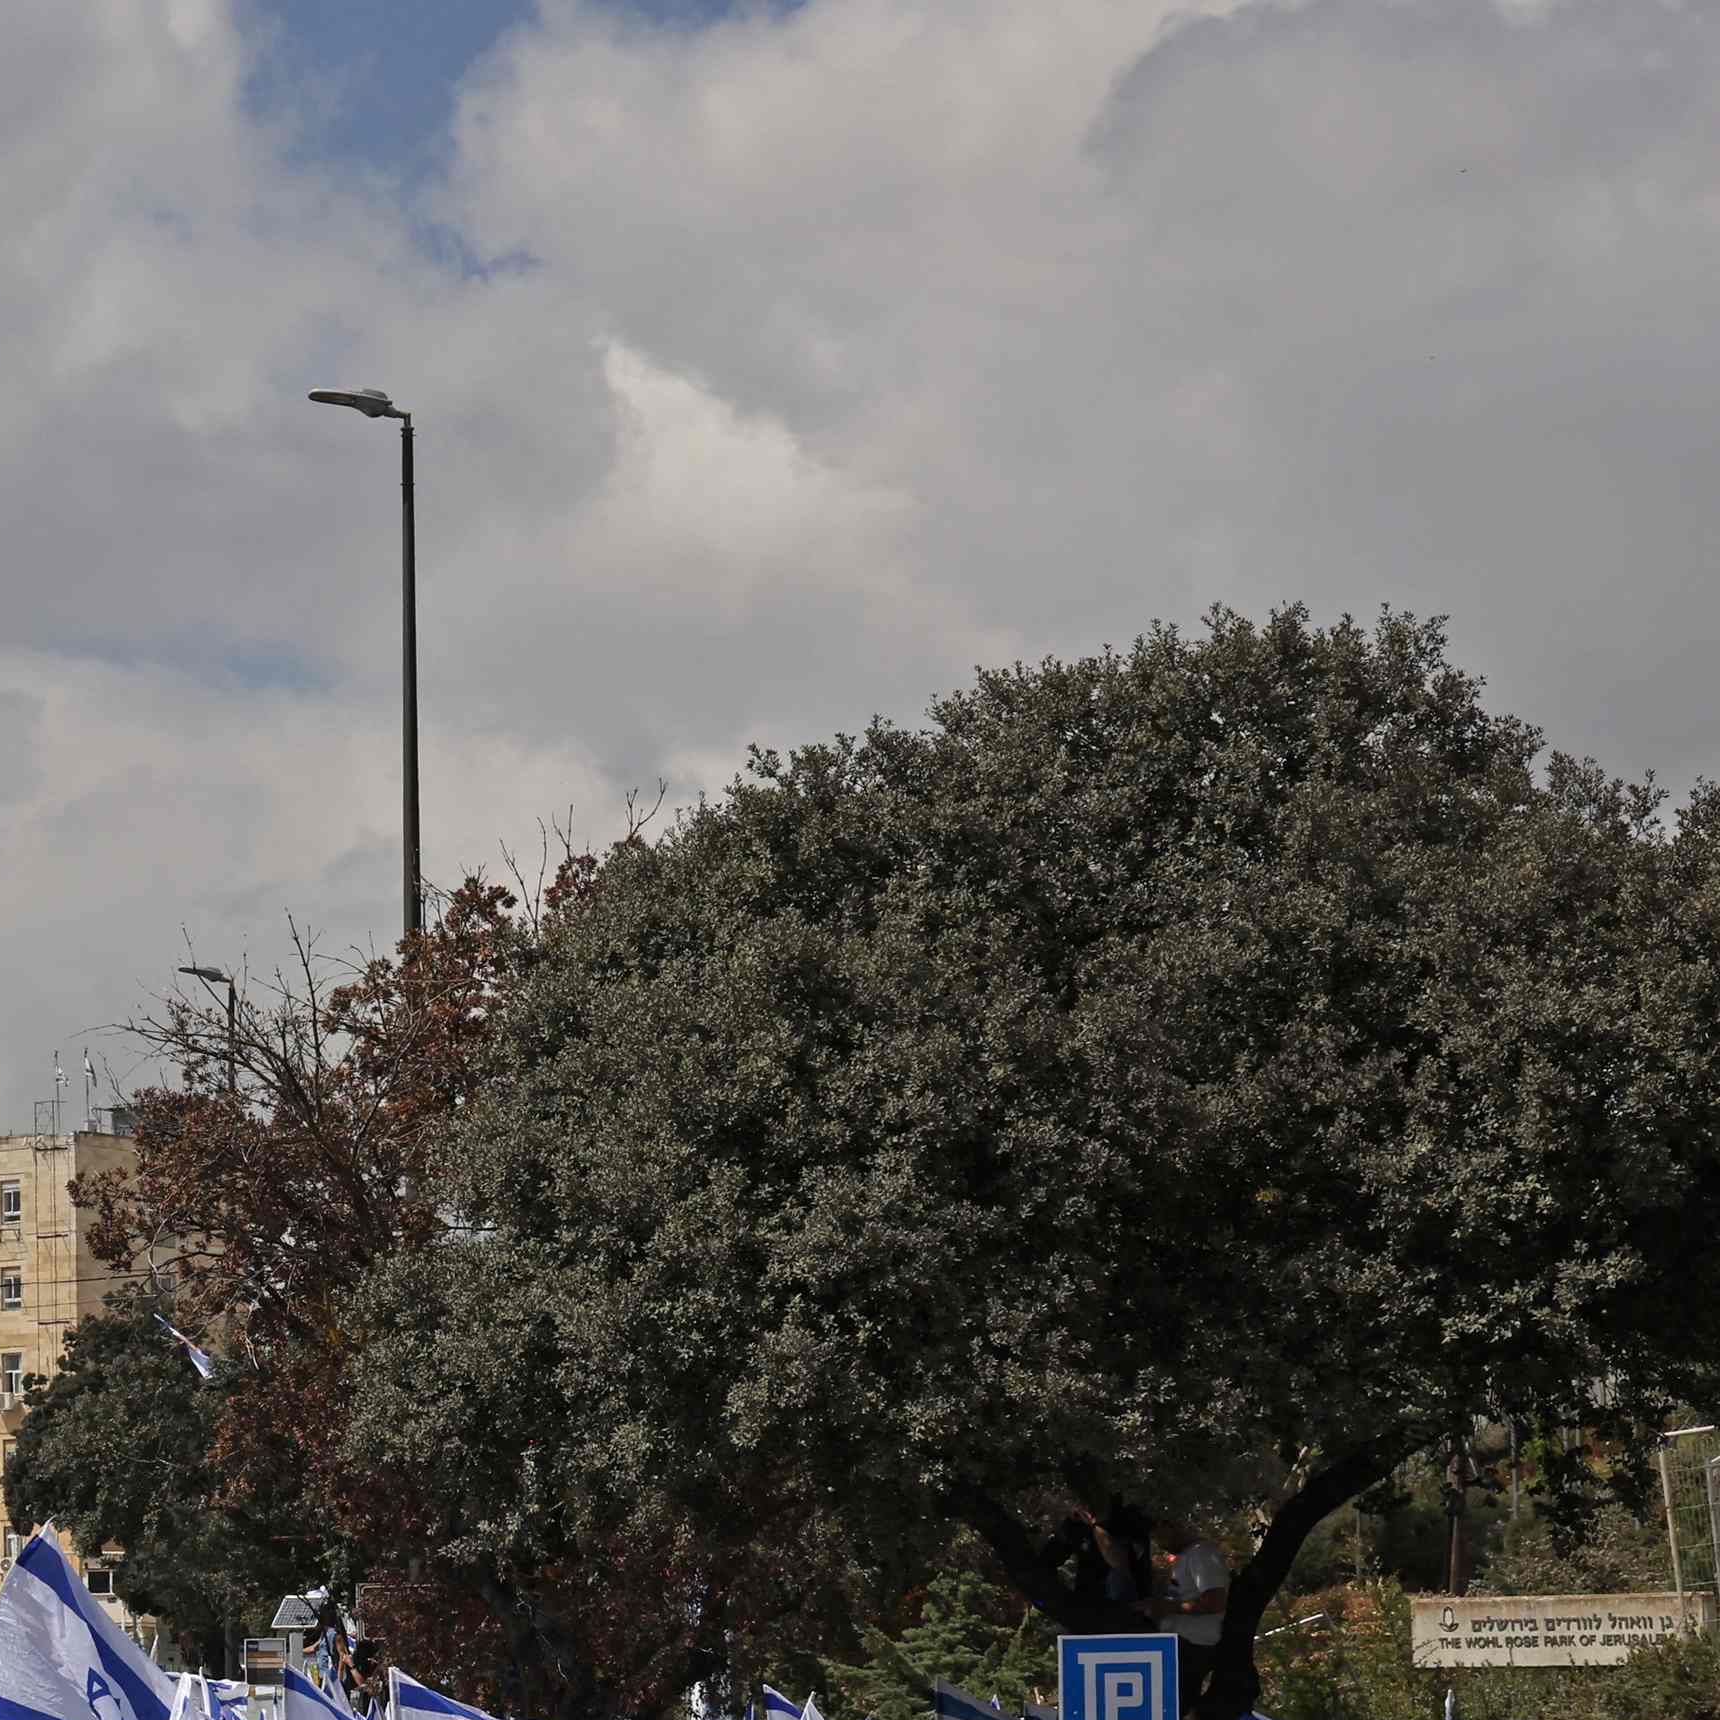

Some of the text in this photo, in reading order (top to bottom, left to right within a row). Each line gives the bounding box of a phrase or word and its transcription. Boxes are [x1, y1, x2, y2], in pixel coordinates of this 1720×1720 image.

[1438, 1637, 1461, 1650] THE
[1465, 1636, 1503, 1650] WOHL
[1504, 1635, 1539, 1649] ROSE
[1544, 1634, 1577, 1648] PARK
[1580, 1634, 1597, 1647] OF
